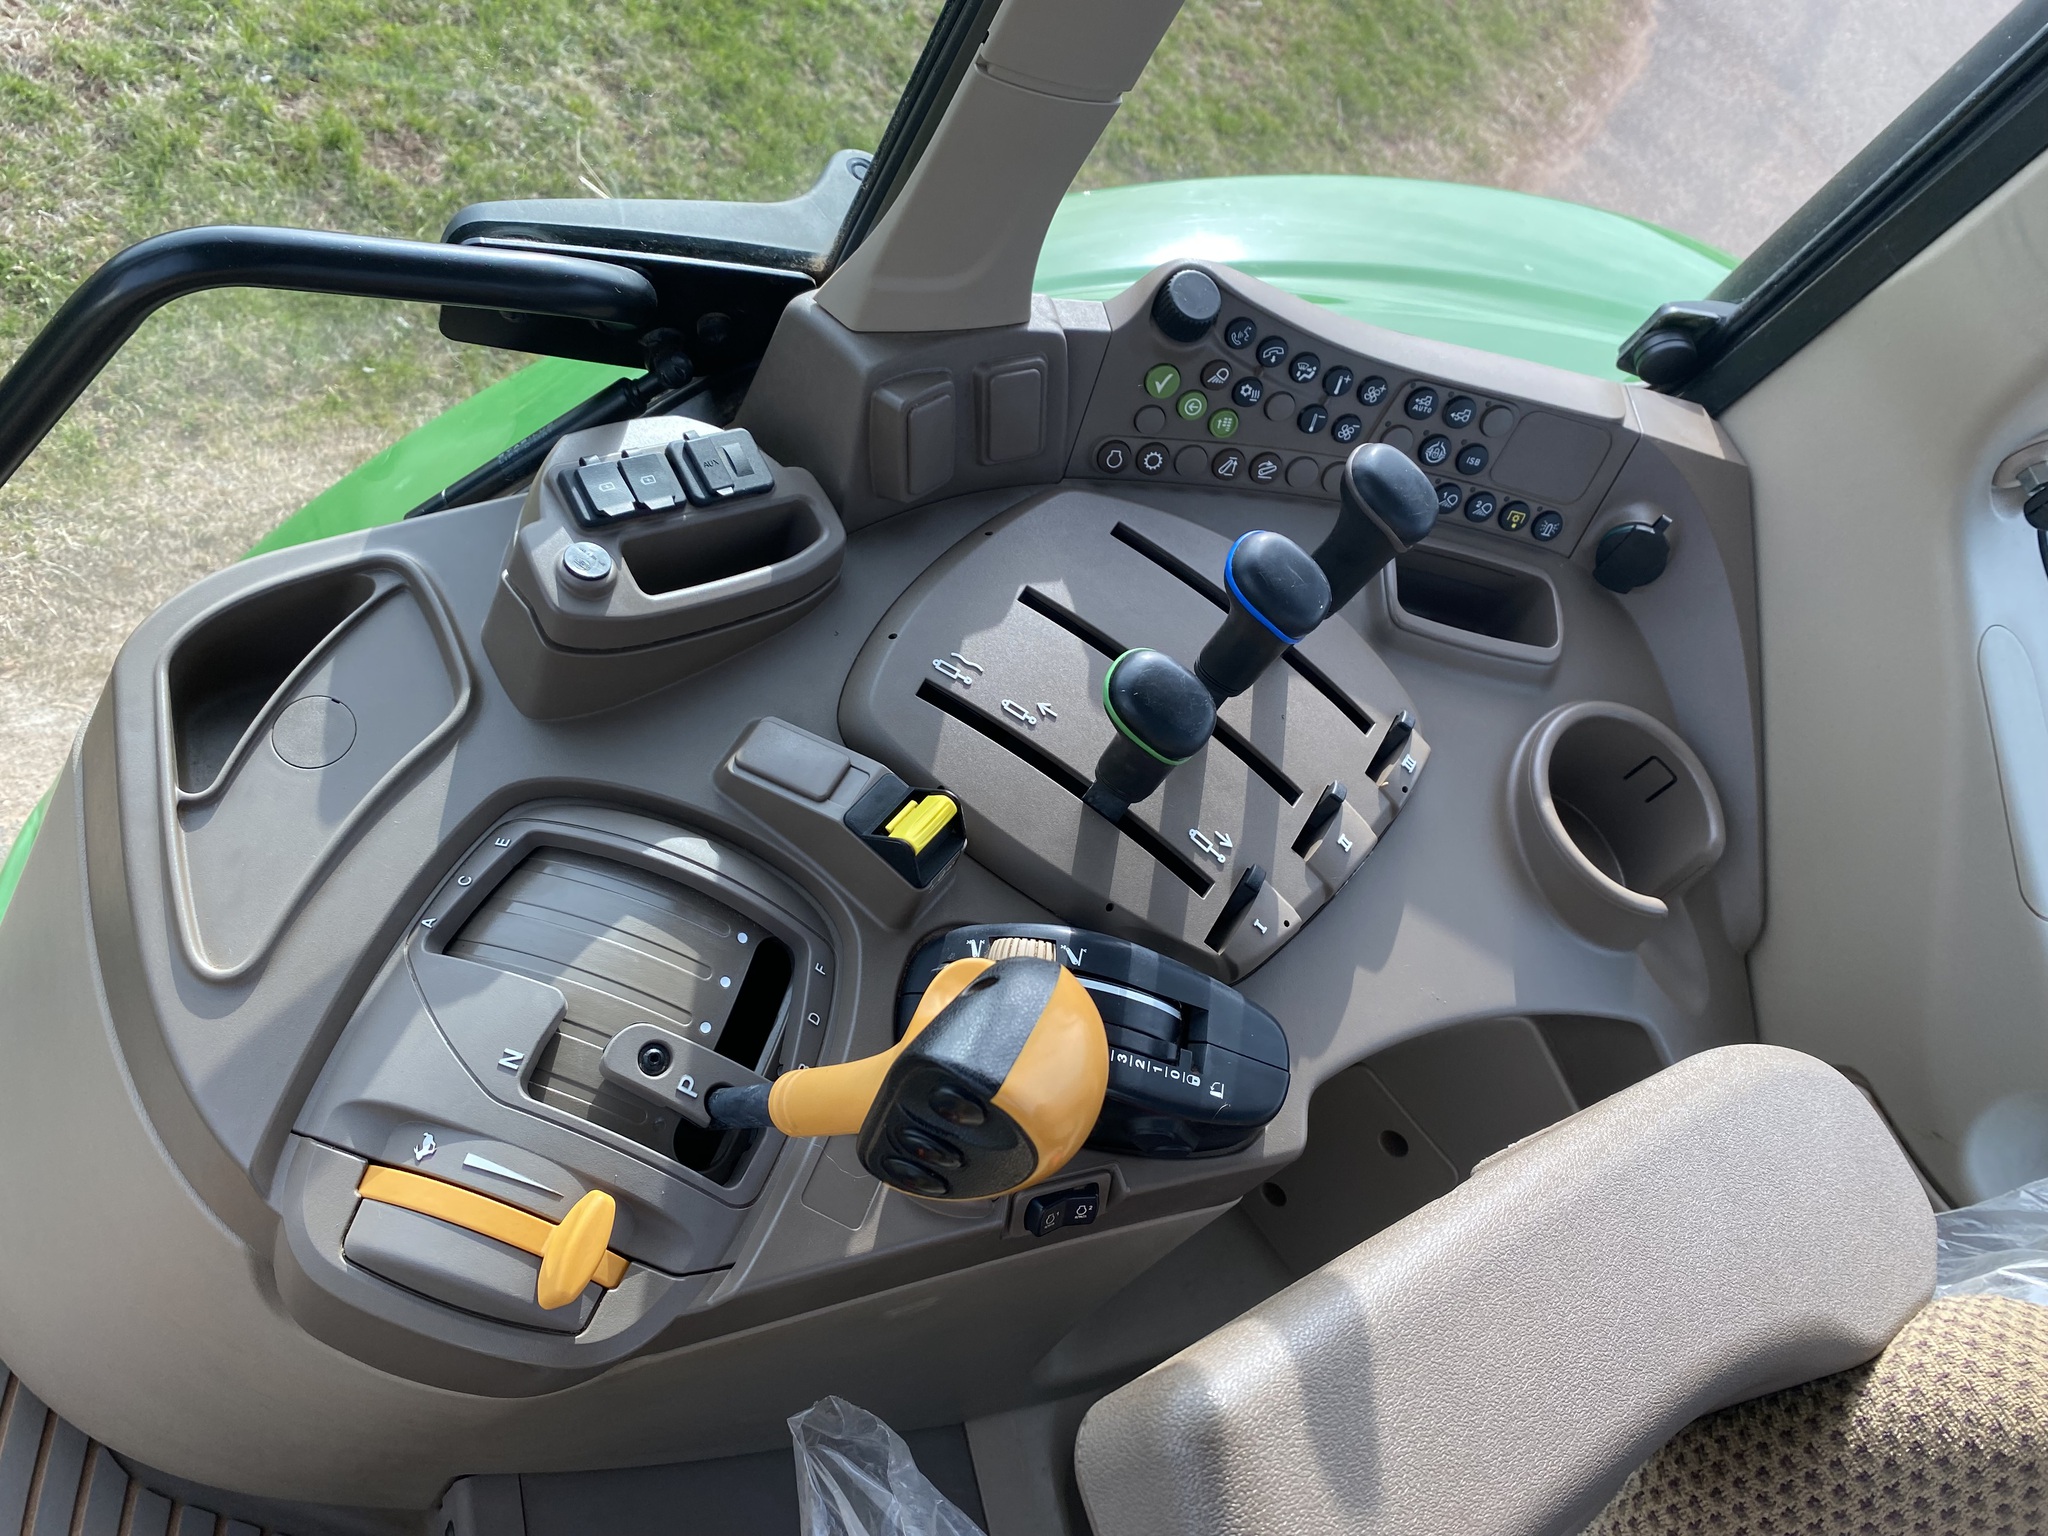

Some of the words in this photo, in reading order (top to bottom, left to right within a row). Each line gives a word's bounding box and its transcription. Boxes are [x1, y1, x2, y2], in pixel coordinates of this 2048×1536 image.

[1412, 404, 1432, 413] AUTO
[1466, 456, 1481, 466] ISB
[1443, 491, 1448, 499] 1
[1476, 500, 1482, 508] 2
[494, 838, 511, 847] E
[1337, 833, 1353, 852] II
[457, 875, 472, 886] C
[421, 918, 437, 928] A
[1253, 918, 1268, 934] I
[815, 962, 826, 975] F
[807, 1012, 820, 1026] D
[498, 1047, 525, 1070] N
[1117, 1053, 1127, 1063] 3
[1135, 1059, 1145, 1069] 2
[1170, 1069, 1180, 1079] 0
[677, 1074, 698, 1098] P
